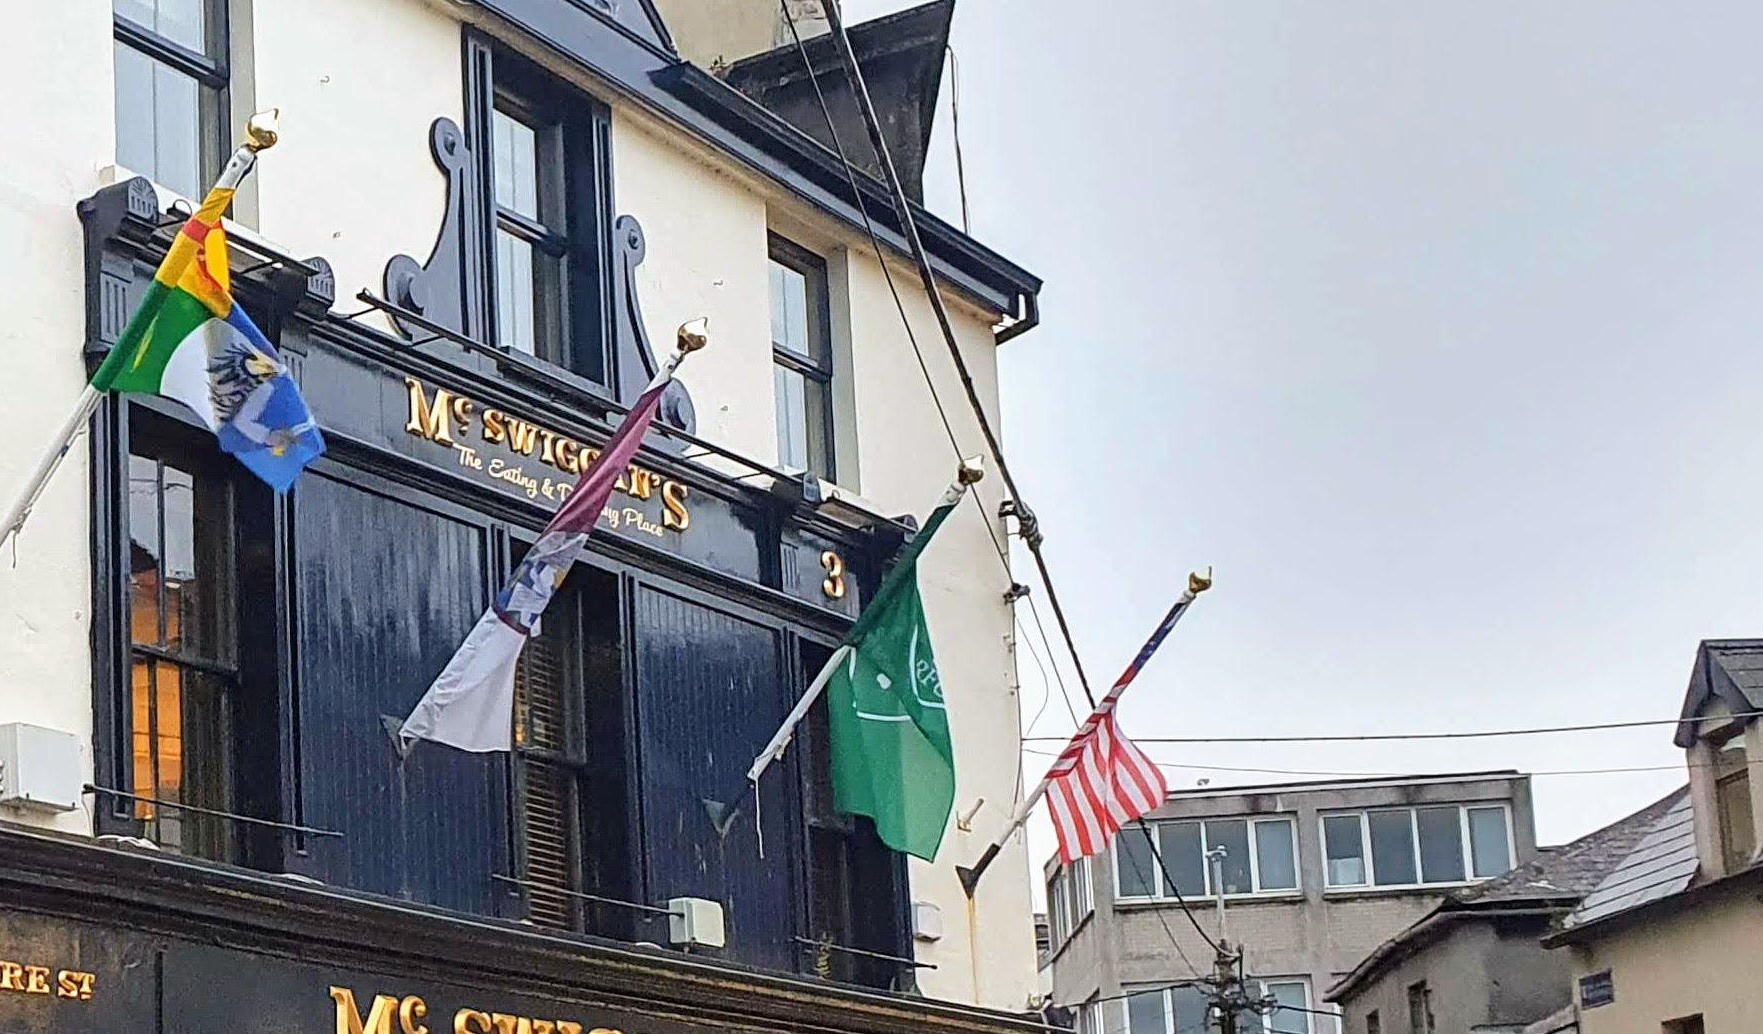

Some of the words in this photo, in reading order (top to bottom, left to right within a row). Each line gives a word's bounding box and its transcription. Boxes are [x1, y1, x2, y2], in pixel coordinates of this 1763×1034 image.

[453, 443, 483, 470] The
[488, 458, 538, 499] Eating
[542, 478, 555, 500] &
[623, 507, 665, 537] Place
[822, 550, 845, 598] 3
[57, 969, 96, 1000] ST
